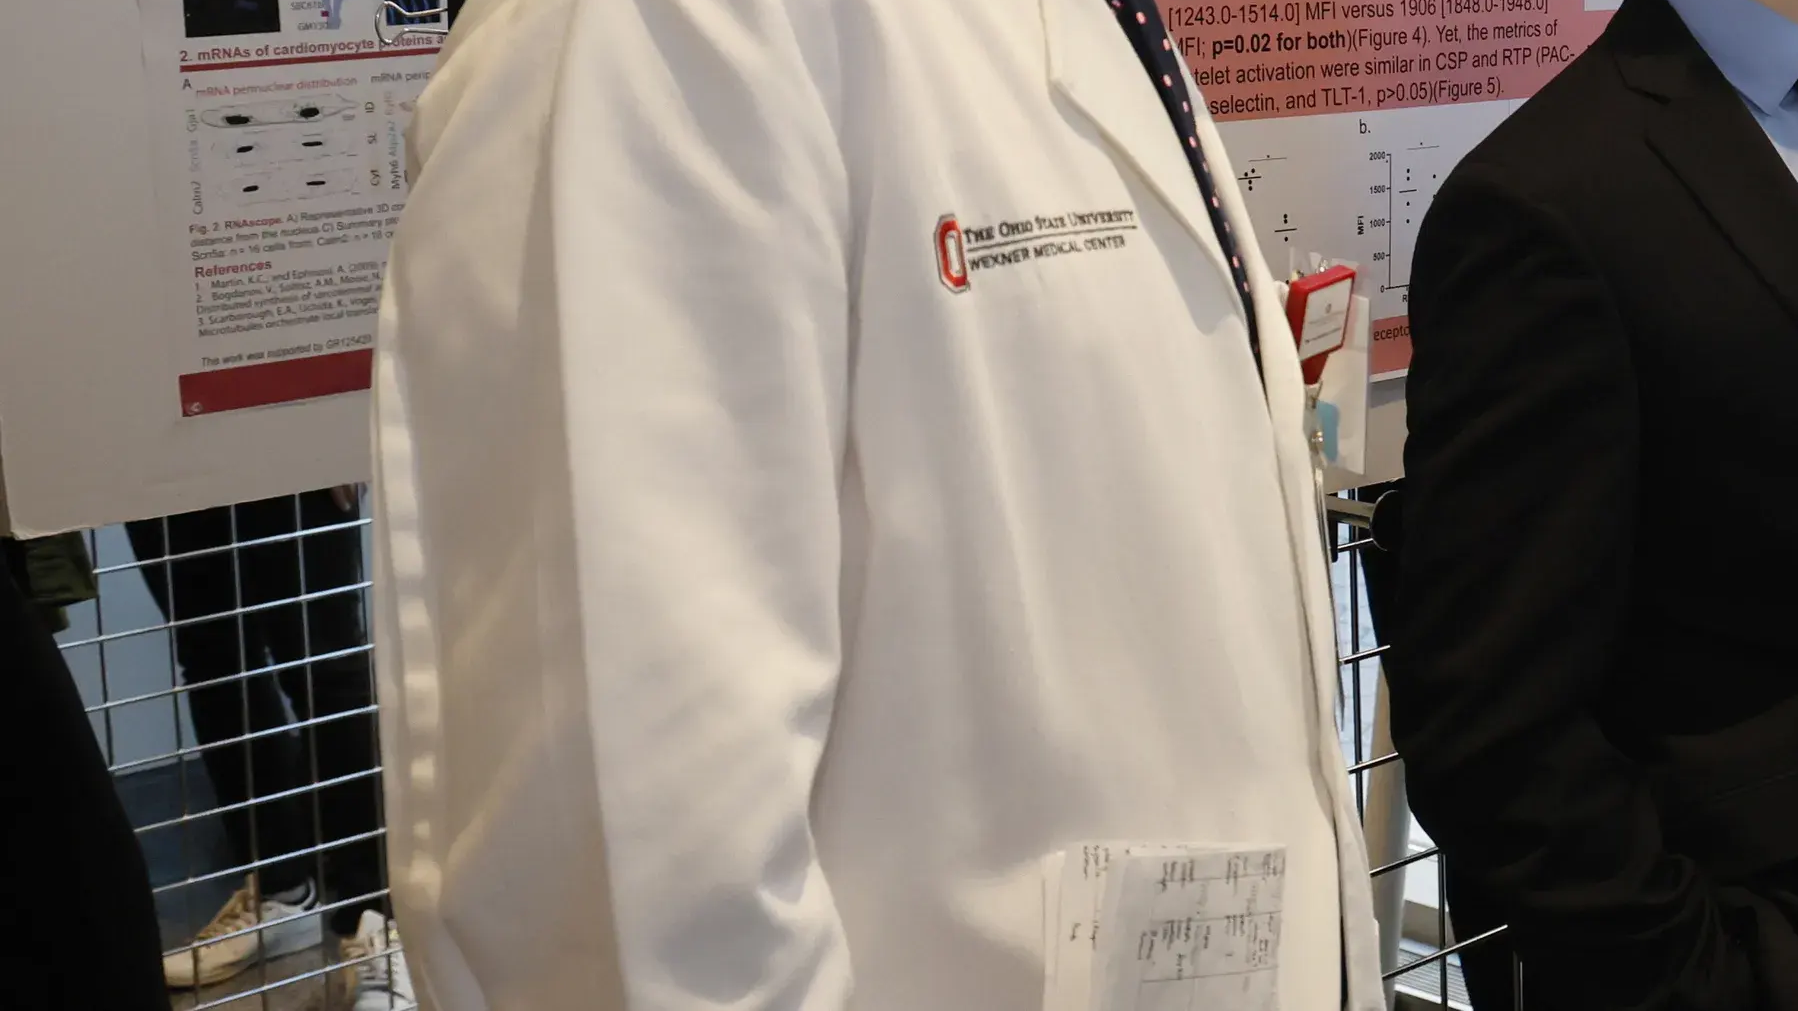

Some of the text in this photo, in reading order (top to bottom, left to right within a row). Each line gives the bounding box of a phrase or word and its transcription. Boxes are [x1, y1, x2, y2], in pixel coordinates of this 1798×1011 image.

[1212, 18, 1558, 60] p=0.02 for both)(Figure 4). Yet, the metrics of
[180, 50, 193, 62] 2.
[198, 46, 250, 62] mRNAs
[256, 43, 270, 56] of
[273, 39, 375, 56] cardiomyocyte
[1359, 119, 1371, 134] b.
[1369, 151, 1386, 161] 2000
[1369, 185, 1386, 195] 1500
[1357, 215, 1365, 236] MFI
[1369, 218, 1386, 228] 1000
[968, 235, 1126, 271] WEXNER MEDICAL CENTER
[195, 260, 272, 278] References
